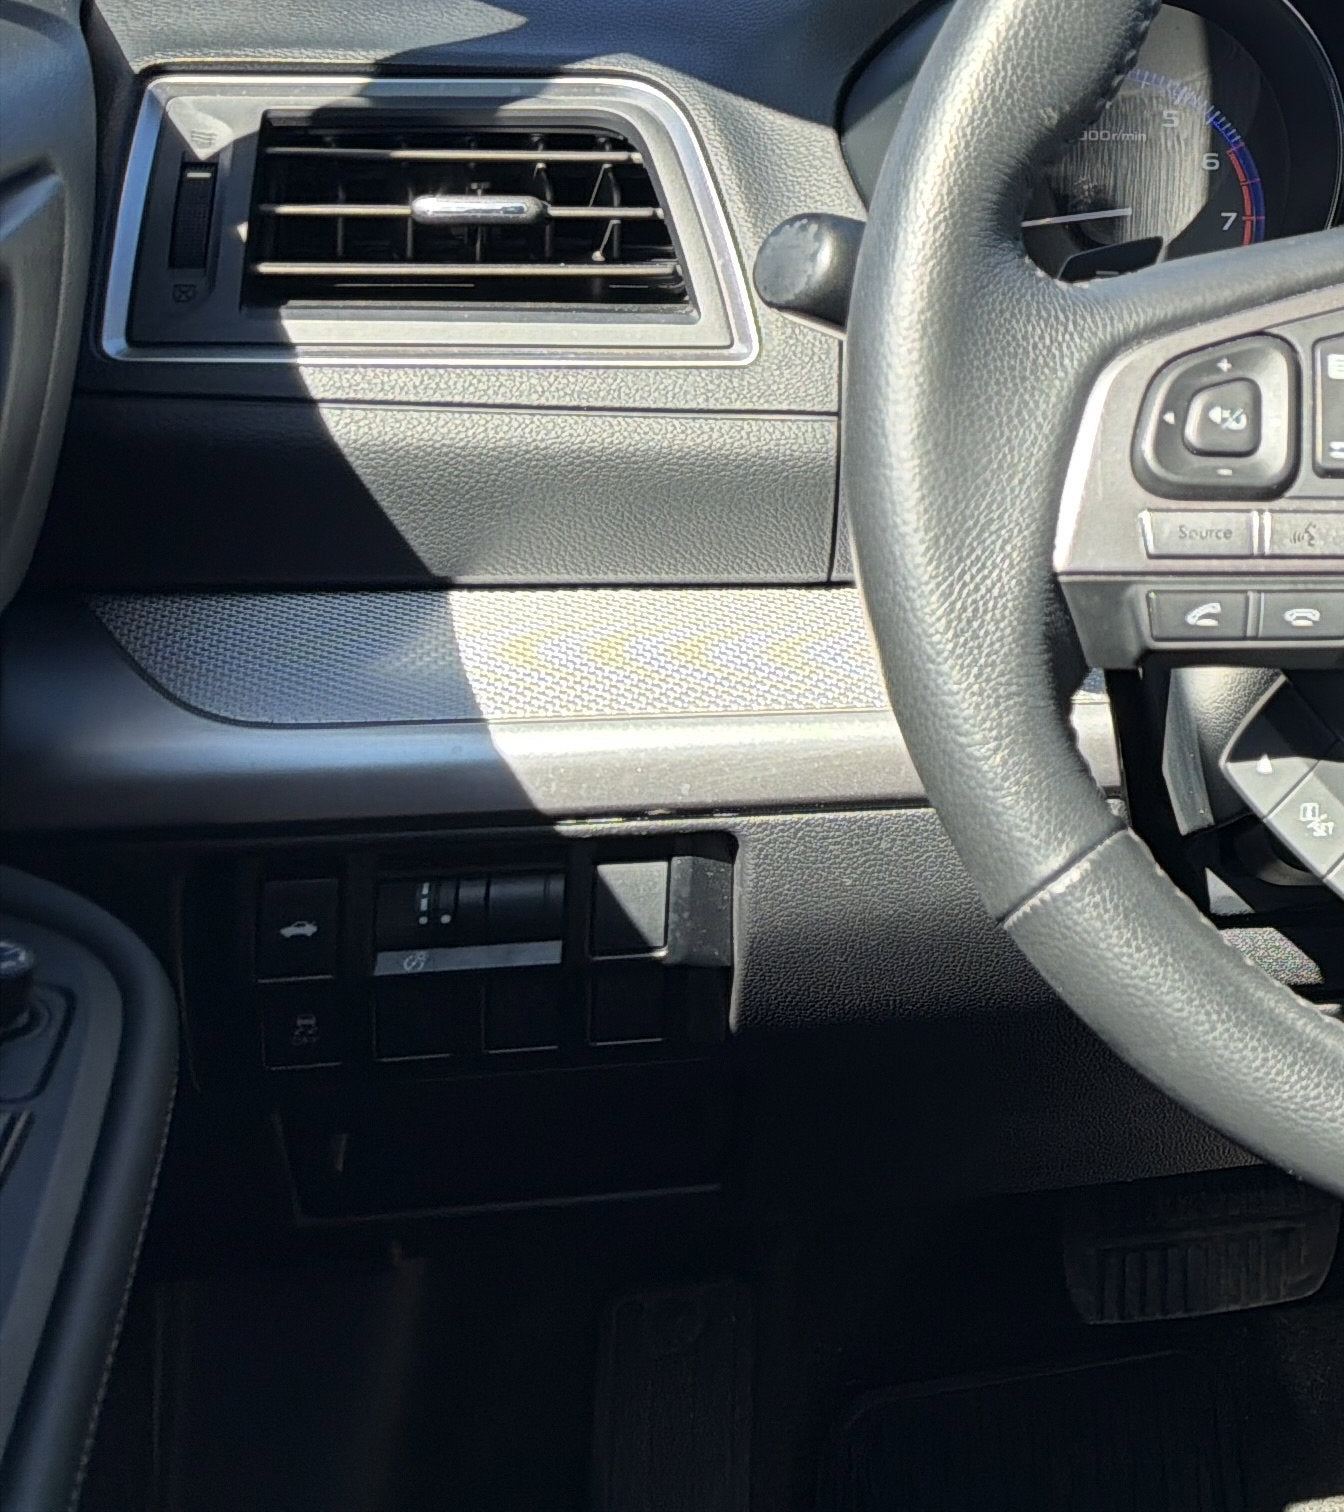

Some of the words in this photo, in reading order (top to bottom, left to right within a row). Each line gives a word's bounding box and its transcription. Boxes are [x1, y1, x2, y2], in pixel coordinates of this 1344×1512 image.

[1162, 110, 1179, 128] 5
[1202, 153, 1219, 171] 6
[1220, 212, 1238, 231] 7
[1178, 524, 1233, 541] Source
